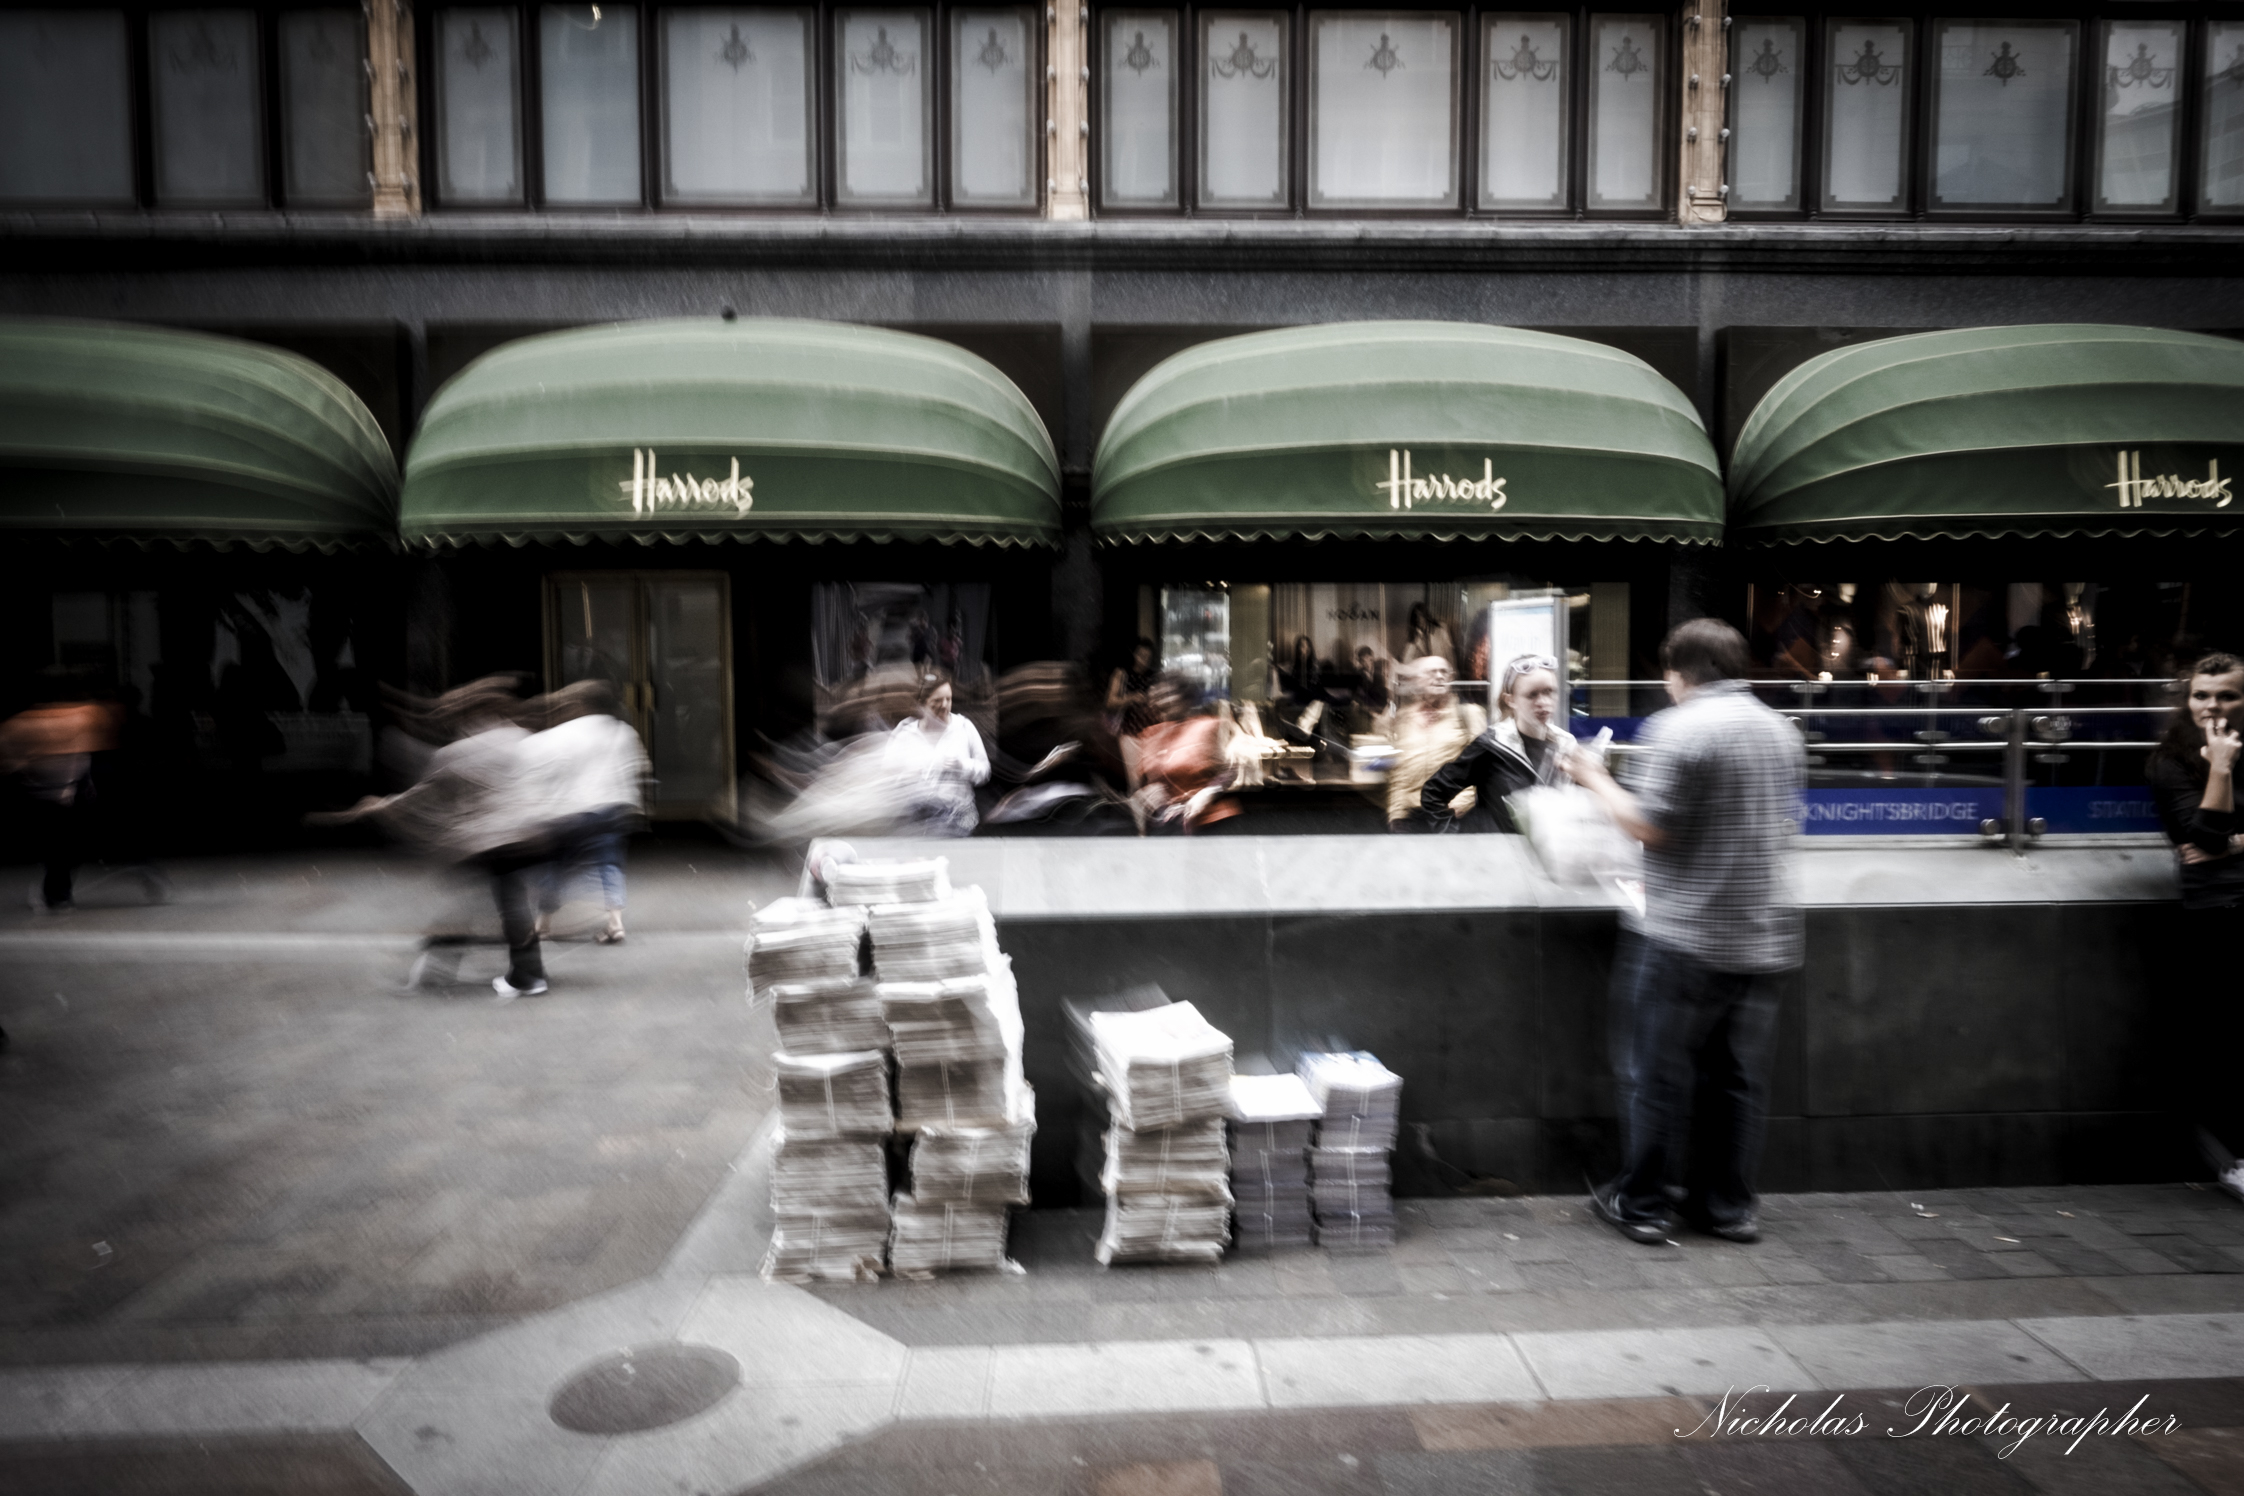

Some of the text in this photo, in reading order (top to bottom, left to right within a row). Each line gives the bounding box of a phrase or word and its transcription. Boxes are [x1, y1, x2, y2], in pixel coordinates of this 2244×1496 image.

[618, 447, 754, 515] Harrods
[1375, 448, 1507, 510] Harrods
[2103, 450, 2233, 508] Harrods
[1801, 802, 1980, 821] KNIGHTSBRIDGE
